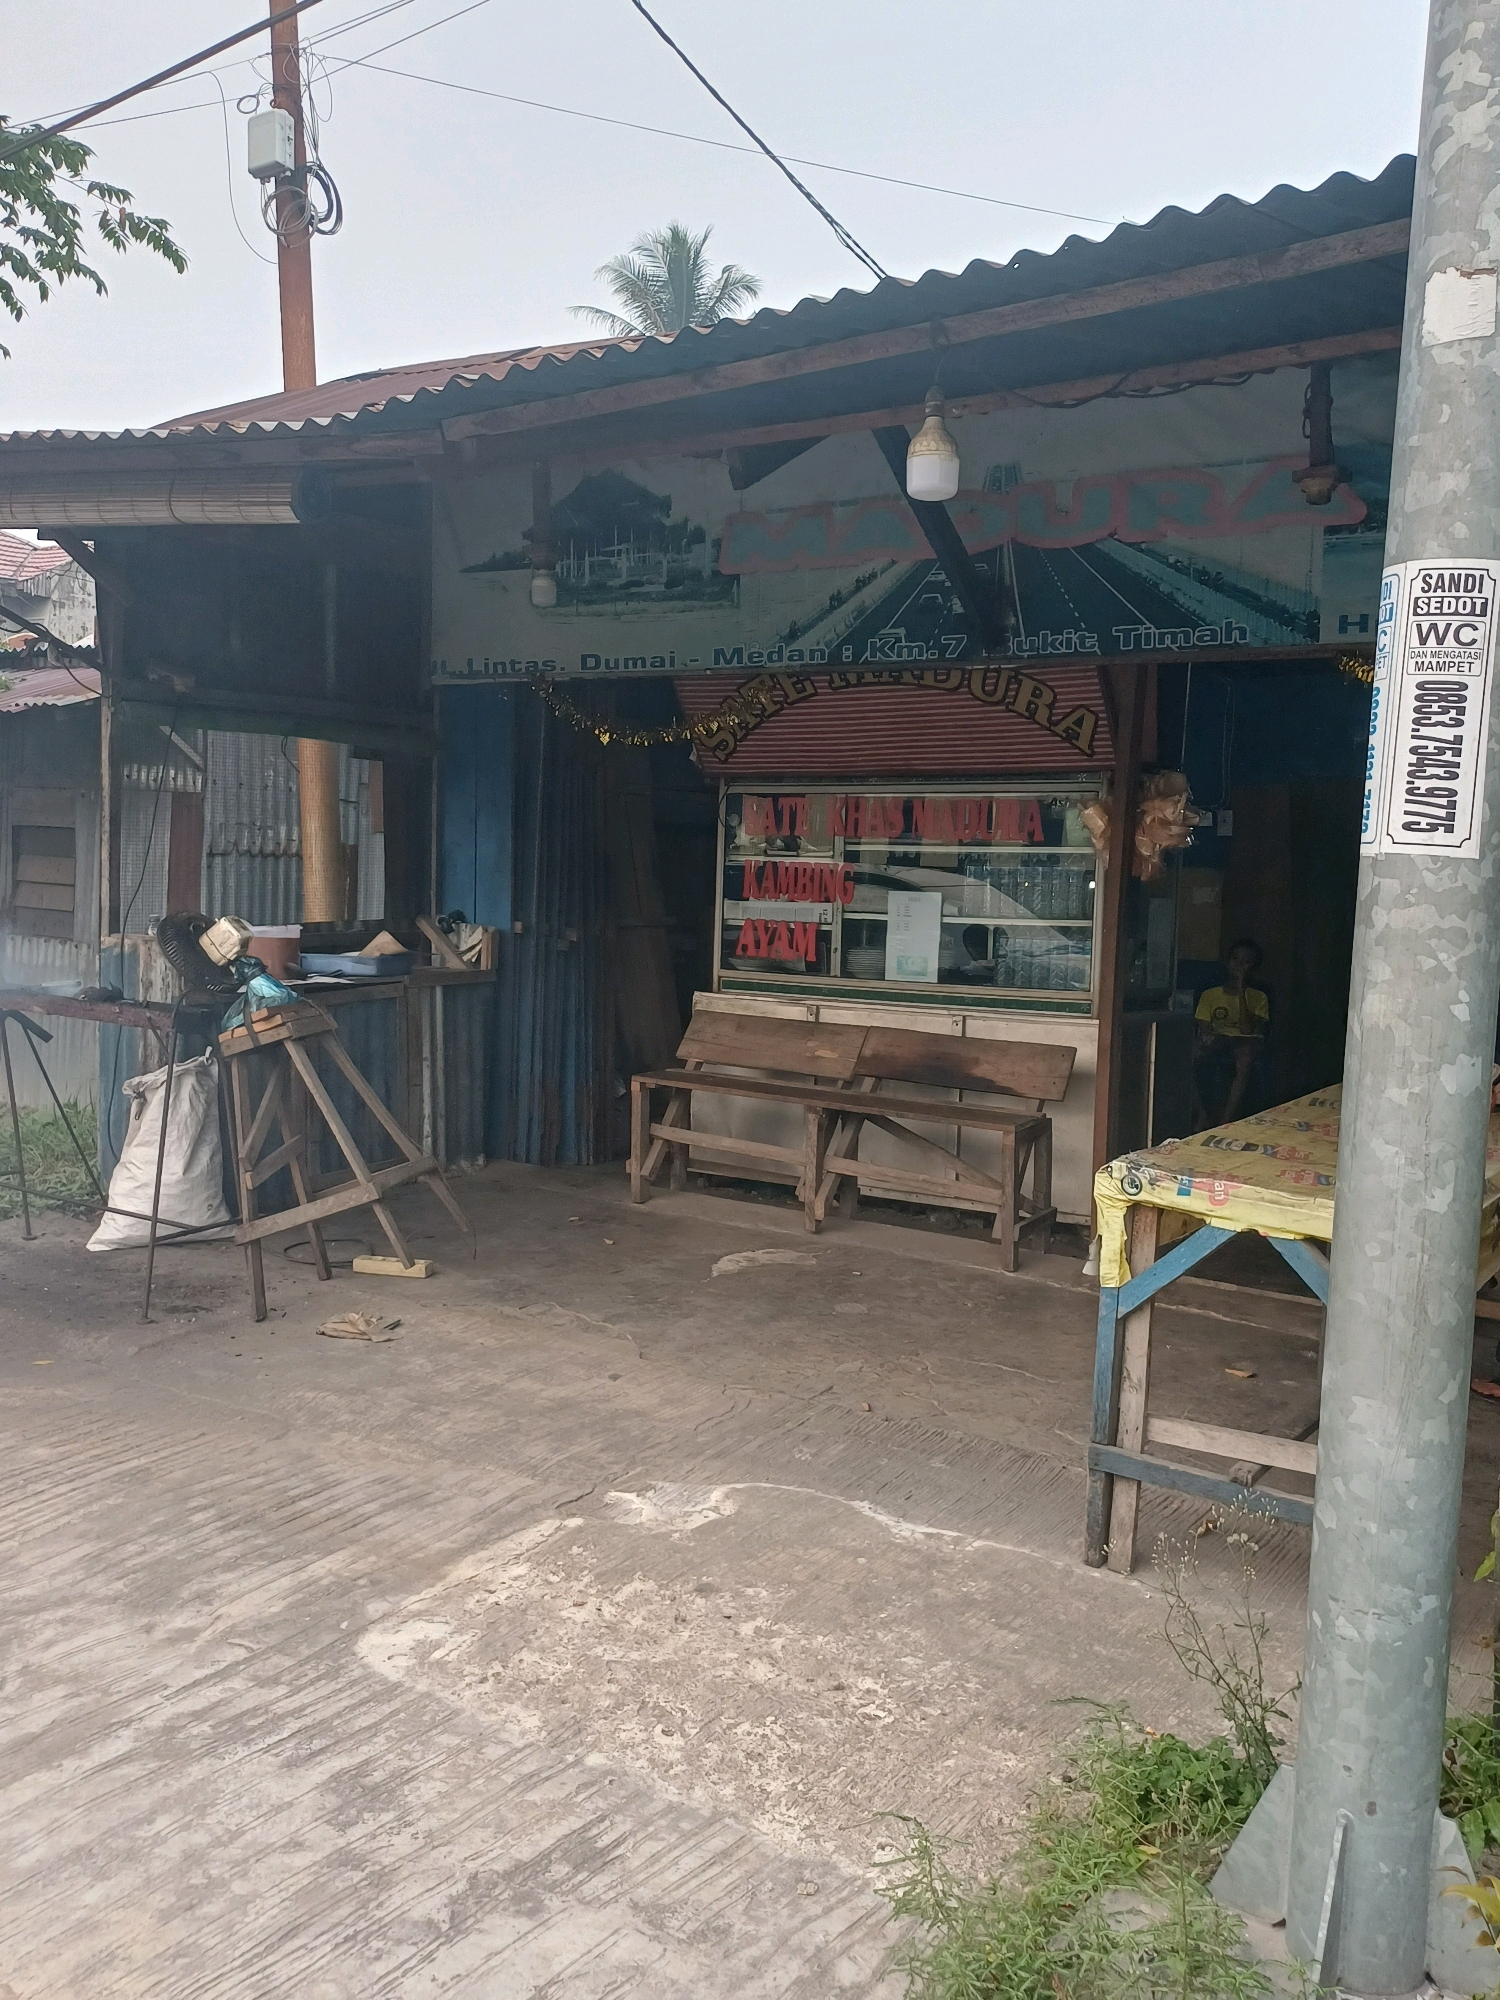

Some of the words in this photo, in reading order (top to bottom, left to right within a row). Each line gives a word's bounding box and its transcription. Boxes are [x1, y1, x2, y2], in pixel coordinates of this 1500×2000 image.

[719, 453, 1366, 575] MADURA
[1420, 572, 1485, 594] SANDI
[1416, 597, 1486, 615] SEDOT
[580, 651, 676, 671] Dumai
[712, 643, 829, 667] Medan
[867, 635, 968, 662] Km.7
[1112, 618, 1249, 650] Timah
[1410, 650, 1428, 660] DAN
[1429, 650, 1482, 661] MENGATASI
[1416, 622, 1479, 647] WC
[1414, 661, 1475, 673] MAMPET
[1401, 680, 1468, 834] 0853.7543.9775
[827, 796, 905, 838] KHAS
[912, 797, 1044, 841] MADURA
[743, 859, 855, 905] KAMBING
[736, 917, 818, 962] AYAM
